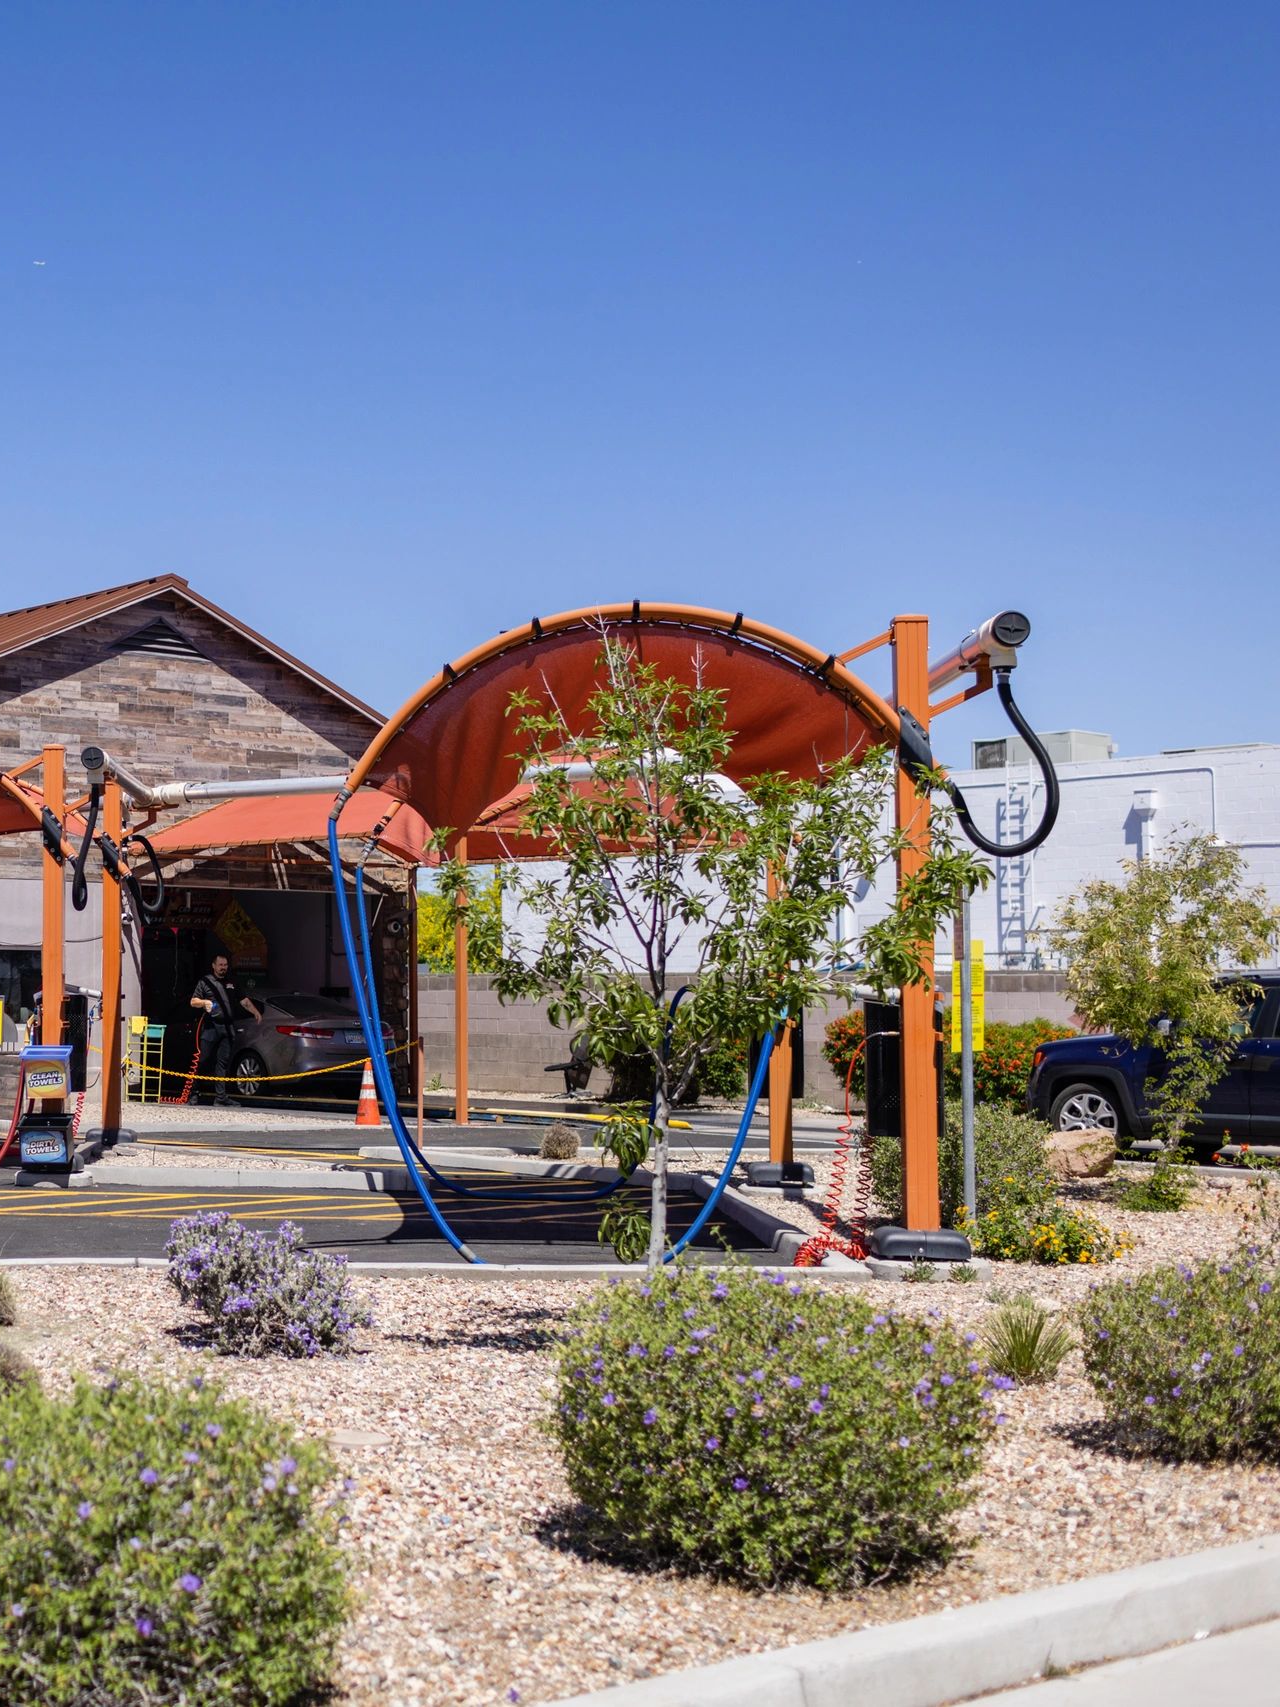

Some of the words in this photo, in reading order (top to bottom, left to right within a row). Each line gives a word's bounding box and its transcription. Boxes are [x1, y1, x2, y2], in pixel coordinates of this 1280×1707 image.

[30, 1071, 58, 1080] CLEAN
[28, 1077, 63, 1087] TOWELS
[30, 1139, 55, 1148] DIRTY
[26, 1145, 59, 1155] TOWELS
